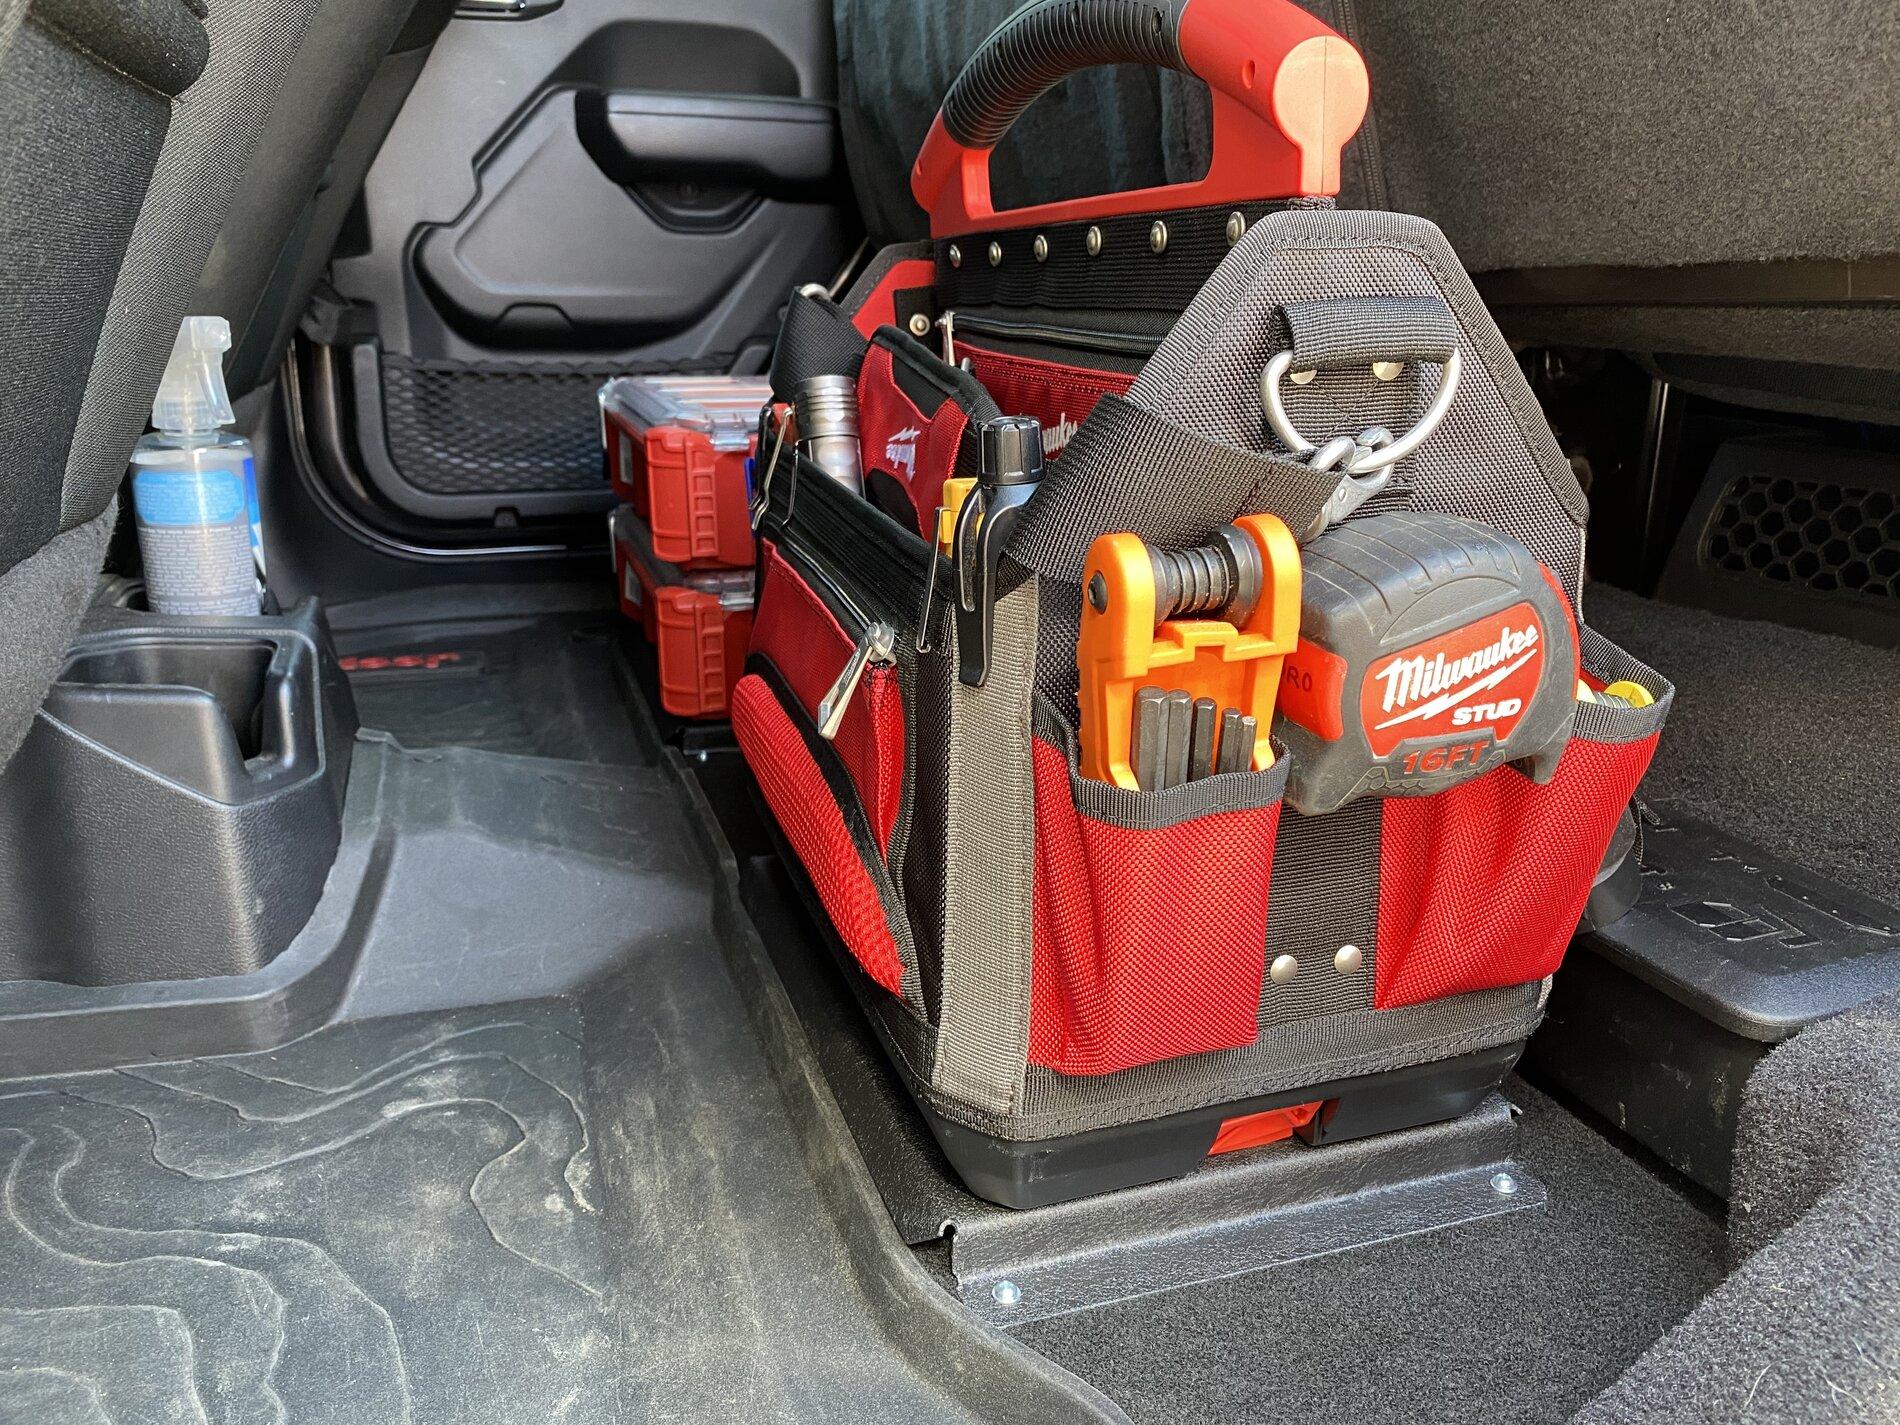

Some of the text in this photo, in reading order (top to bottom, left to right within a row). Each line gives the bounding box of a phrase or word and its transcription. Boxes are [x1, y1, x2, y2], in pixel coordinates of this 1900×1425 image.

[1375, 624, 1540, 713] Milwaukee
[1451, 698, 1523, 726] STUD
[1403, 740, 1490, 775] 16FT
